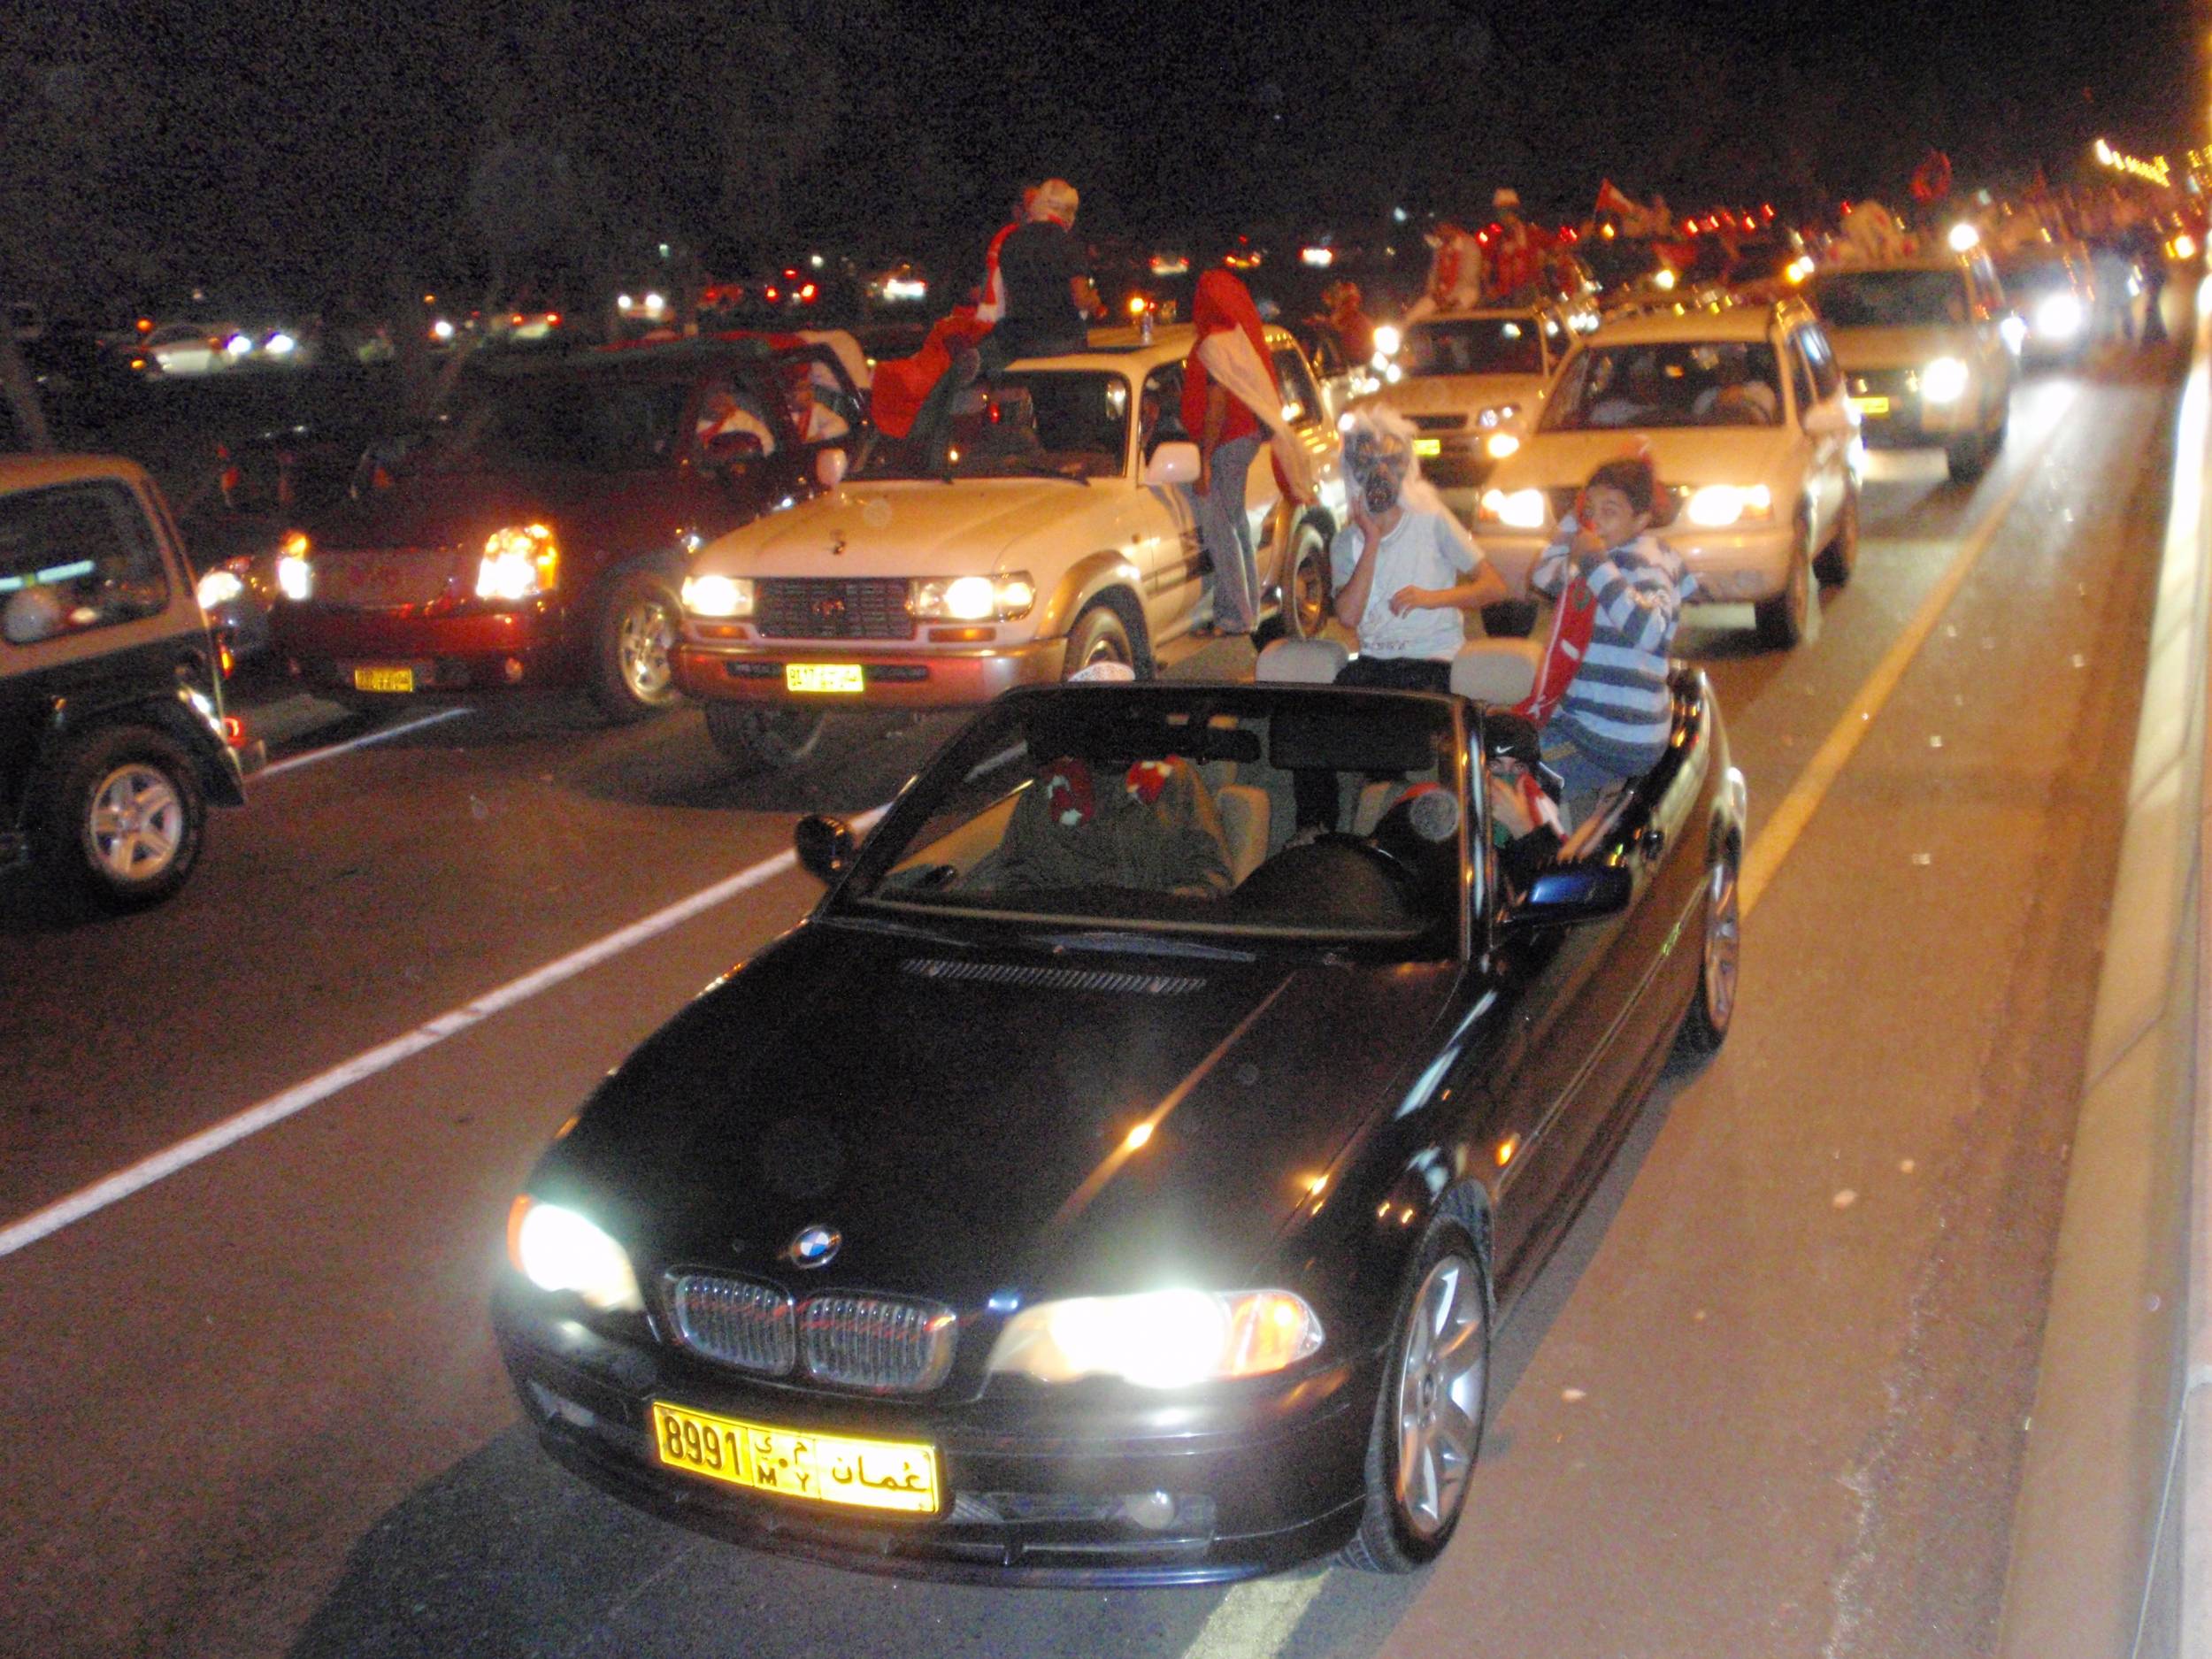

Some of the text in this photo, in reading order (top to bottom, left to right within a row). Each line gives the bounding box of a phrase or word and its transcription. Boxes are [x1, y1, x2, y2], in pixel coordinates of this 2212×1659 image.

[665, 1416, 740, 1476] 8991
[758, 1465, 809, 1492] M Y
